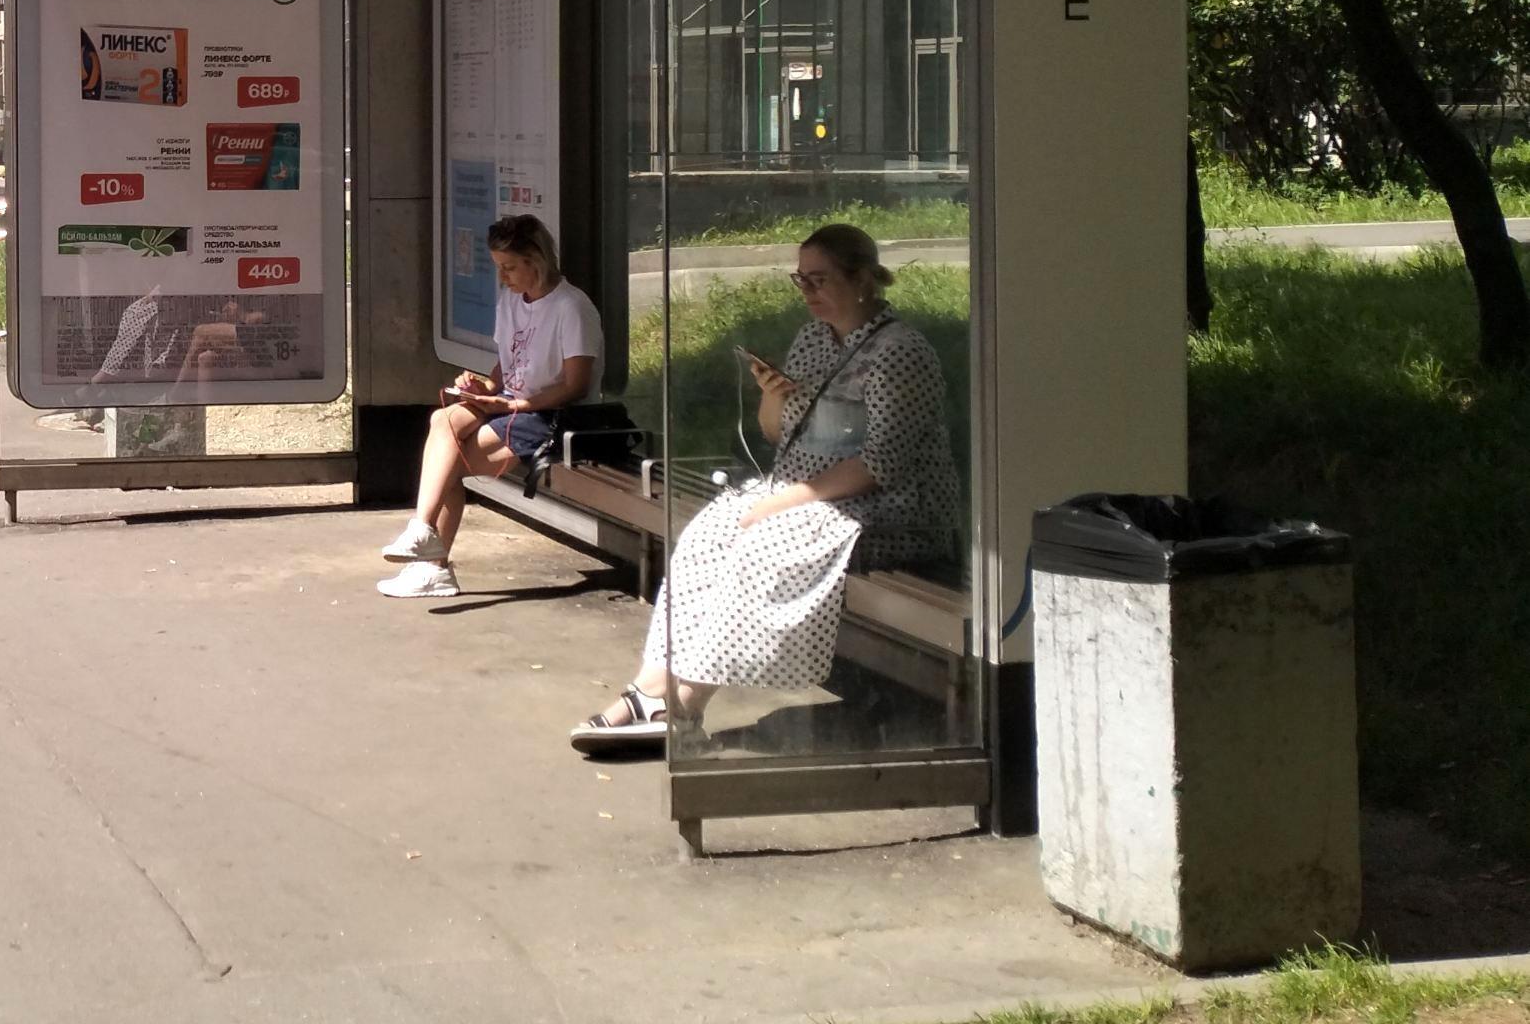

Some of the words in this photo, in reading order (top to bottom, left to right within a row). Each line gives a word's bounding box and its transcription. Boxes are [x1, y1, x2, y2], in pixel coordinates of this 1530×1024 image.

[100, 33, 168, 54] ЛИНЕКС
[204, 55, 240, 63] ЛИНЕКС
[241, 55, 272, 63] ФОРТЕ
[217, 134, 265, 150] Ренни
[160, 147, 191, 155] РЕННИ
[89, 178, 135, 196] -10%
[204, 241, 282, 249] ПСИЛО-БАЛЬЗАМ
[273, 341, 301, 361] 18+
